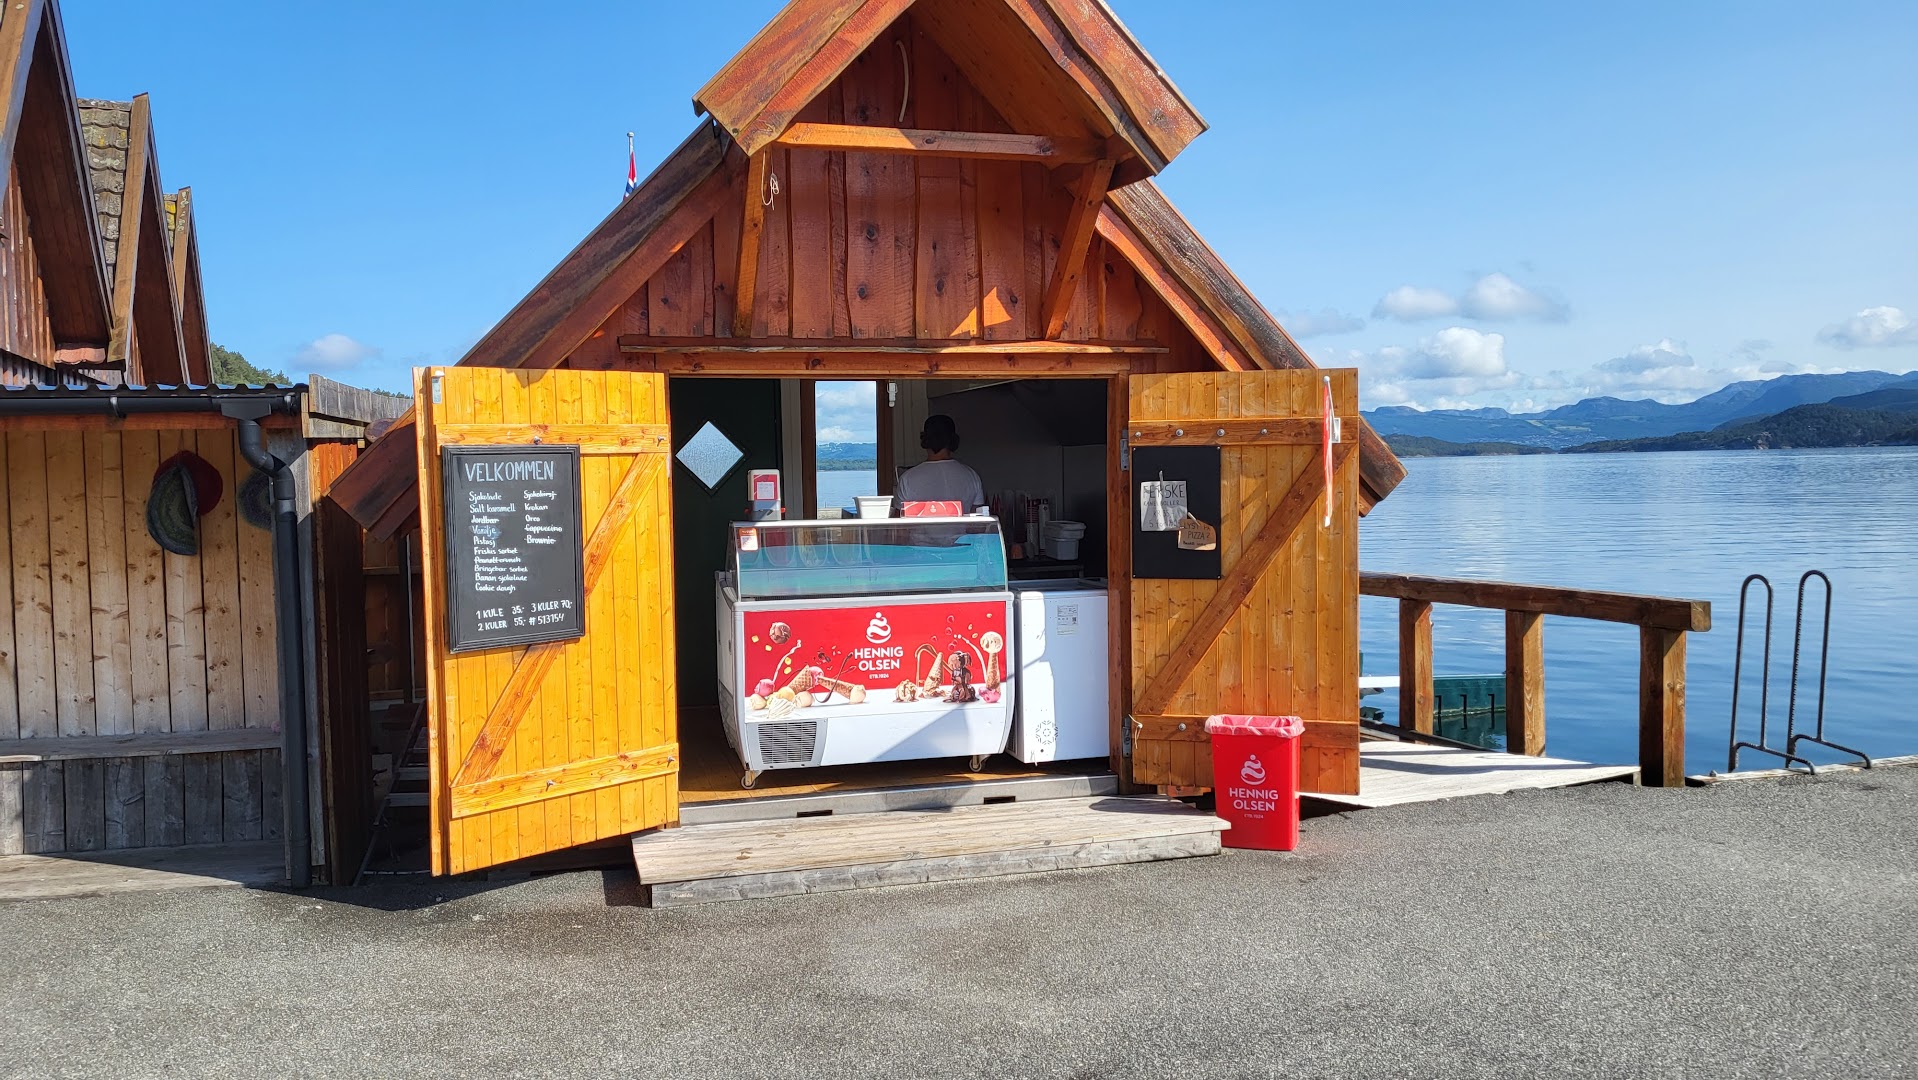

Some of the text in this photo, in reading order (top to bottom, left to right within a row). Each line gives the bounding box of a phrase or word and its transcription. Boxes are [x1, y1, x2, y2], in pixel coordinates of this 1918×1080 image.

[465, 461, 554, 482] VELKOMMEN
[468, 490, 502, 504] Sjokolade
[469, 503, 485, 514] Salt
[525, 502, 548, 511] Krokan
[525, 514, 541, 522] Oreo
[471, 524, 497, 538] Vanilje
[1187, 530, 1205, 540] PIZZA
[498, 547, 519, 555] sorbet
[475, 572, 497, 581] Banan
[475, 582, 516, 595] Cookie dough
[483, 608, 504, 619] KULE
[531, 602, 537, 613] 3
[537, 600, 560, 612] KULER
[477, 622, 484, 632] 2
[485, 619, 508, 631] KULER
[854, 646, 904, 659] HENNIG
[858, 659, 900, 672] OLSEN
[1229, 787, 1279, 800] HENNIG
[1233, 800, 1275, 812] OLSEN
